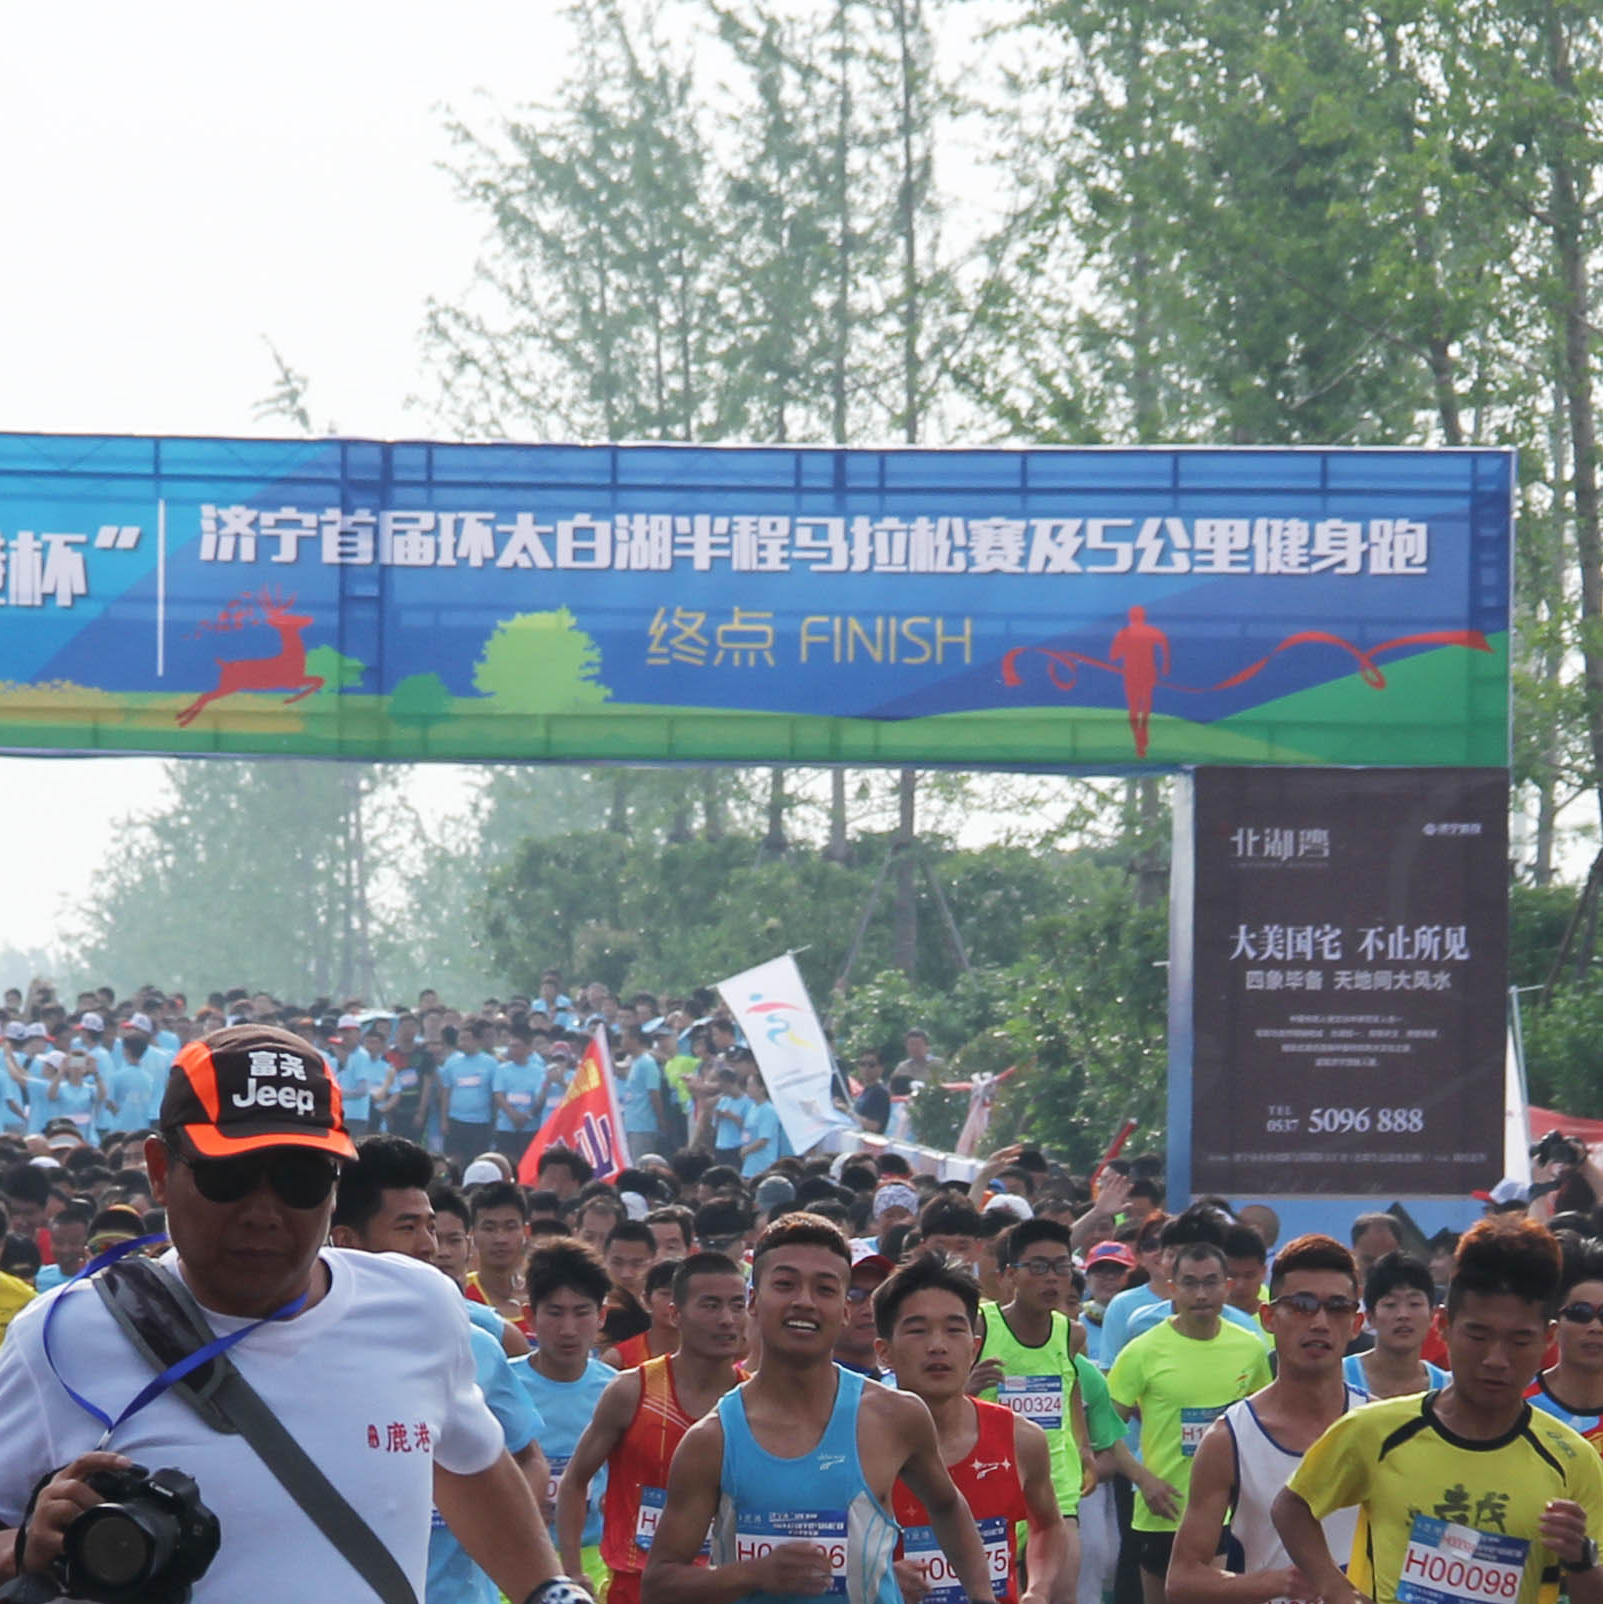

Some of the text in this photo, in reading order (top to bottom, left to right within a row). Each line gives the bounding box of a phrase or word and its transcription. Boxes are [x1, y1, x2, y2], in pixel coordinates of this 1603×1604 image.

[200, 505, 1428, 576] 济宁首届环太白湖半程马拉松赛及5公里健身跑
[645, 607, 973, 668] 终点 FINISH
[1230, 924, 1471, 961] 大美国宅 不止所见
[232, 1078, 314, 1116] Jeep
[1268, 1105, 1293, 1116] TEL
[1308, 1107, 1370, 1134] 5096
[1377, 1107, 1425, 1133] 888
[386, 1421, 430, 1453] 鹿港
[1405, 1549, 1518, 1598] H00098
